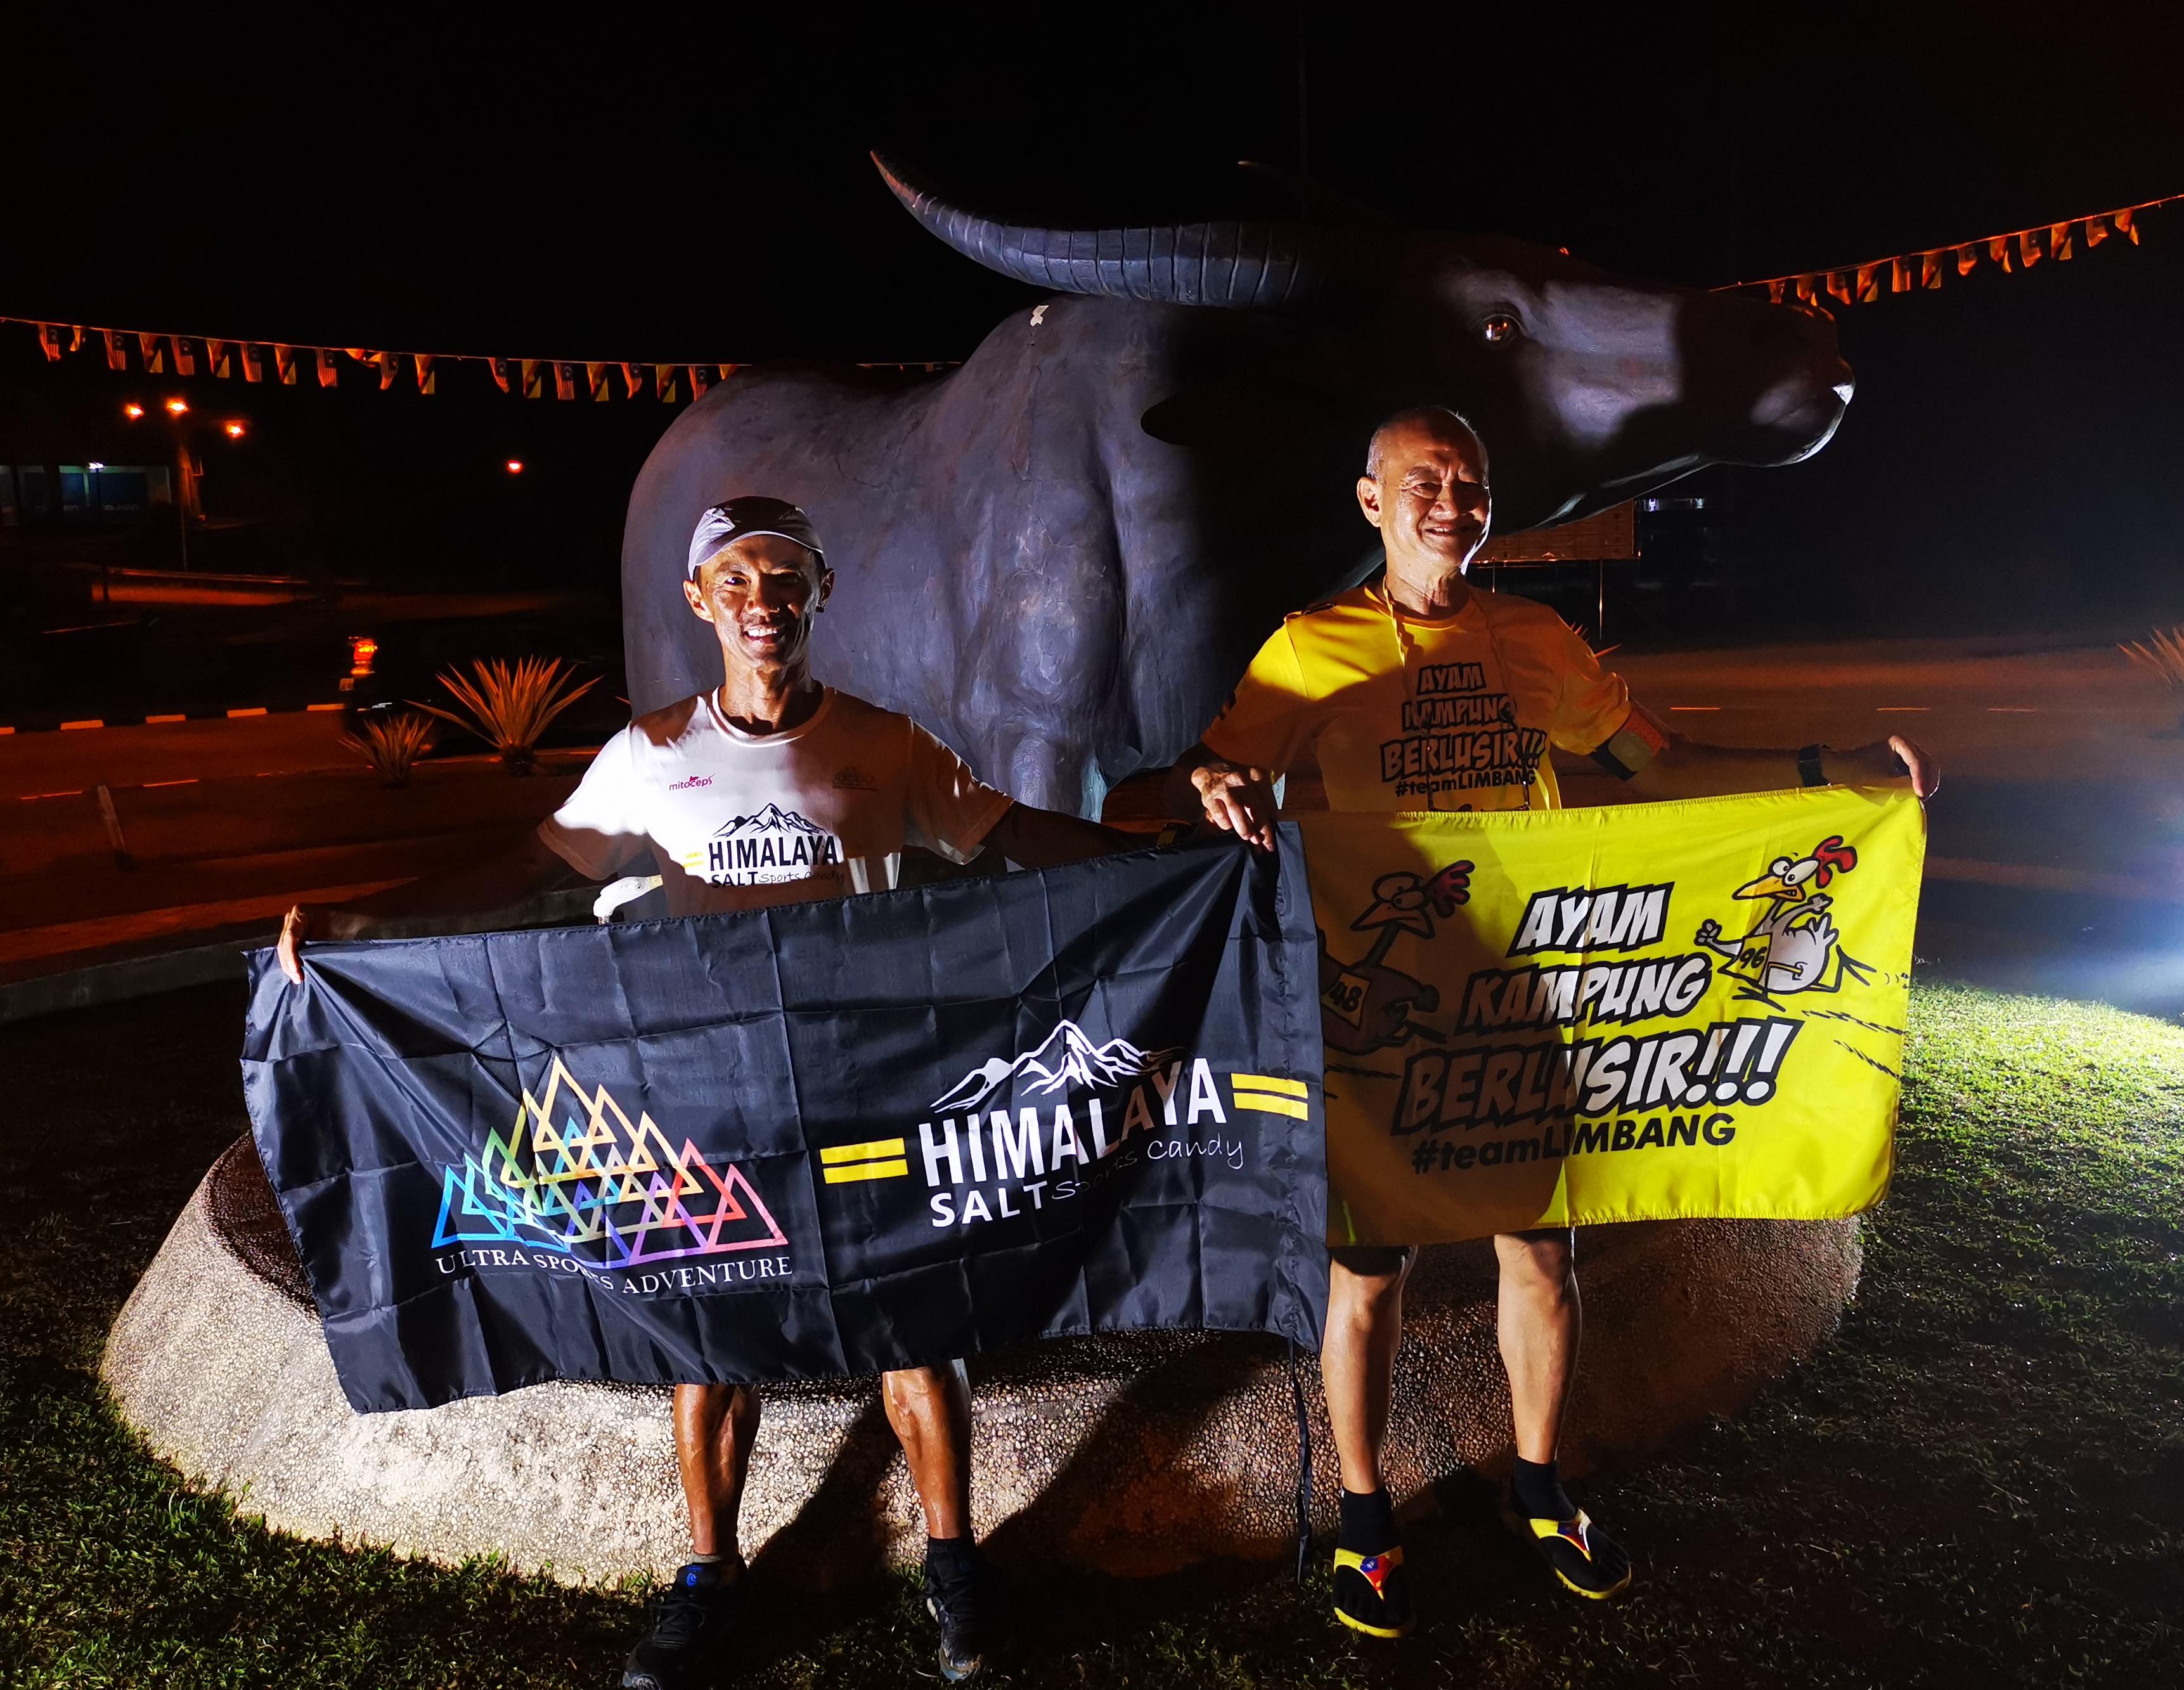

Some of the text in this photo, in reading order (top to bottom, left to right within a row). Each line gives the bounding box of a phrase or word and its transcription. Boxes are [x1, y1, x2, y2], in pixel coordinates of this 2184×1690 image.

[1418, 662, 1485, 695] AYAM
[1402, 694, 1517, 732] KAMPUNG
[1381, 728, 1549, 782] BERLUSIR!!!
[669, 774, 714, 790] mitoceps
[1395, 770, 1537, 797] #teamLIMBANG
[709, 835, 838, 871] HIMALAYA
[711, 872, 758, 888] SALT
[1508, 882, 1674, 957] AYAM
[1740, 946, 1767, 969] 96
[1329, 982, 1362, 1012] 48
[1456, 953, 1711, 1035] KAMPUNG
[1392, 1018, 1804, 1135] BERLUSIR!!!
[919, 1057, 1226, 1187] HIMALAYA
[1412, 1113, 1736, 1174] #teamLIMBANG
[930, 1182, 1050, 1227] SALT
[436, 1248, 530, 1274] ULTRA
[621, 1256, 792, 1294] ADVENTURE
